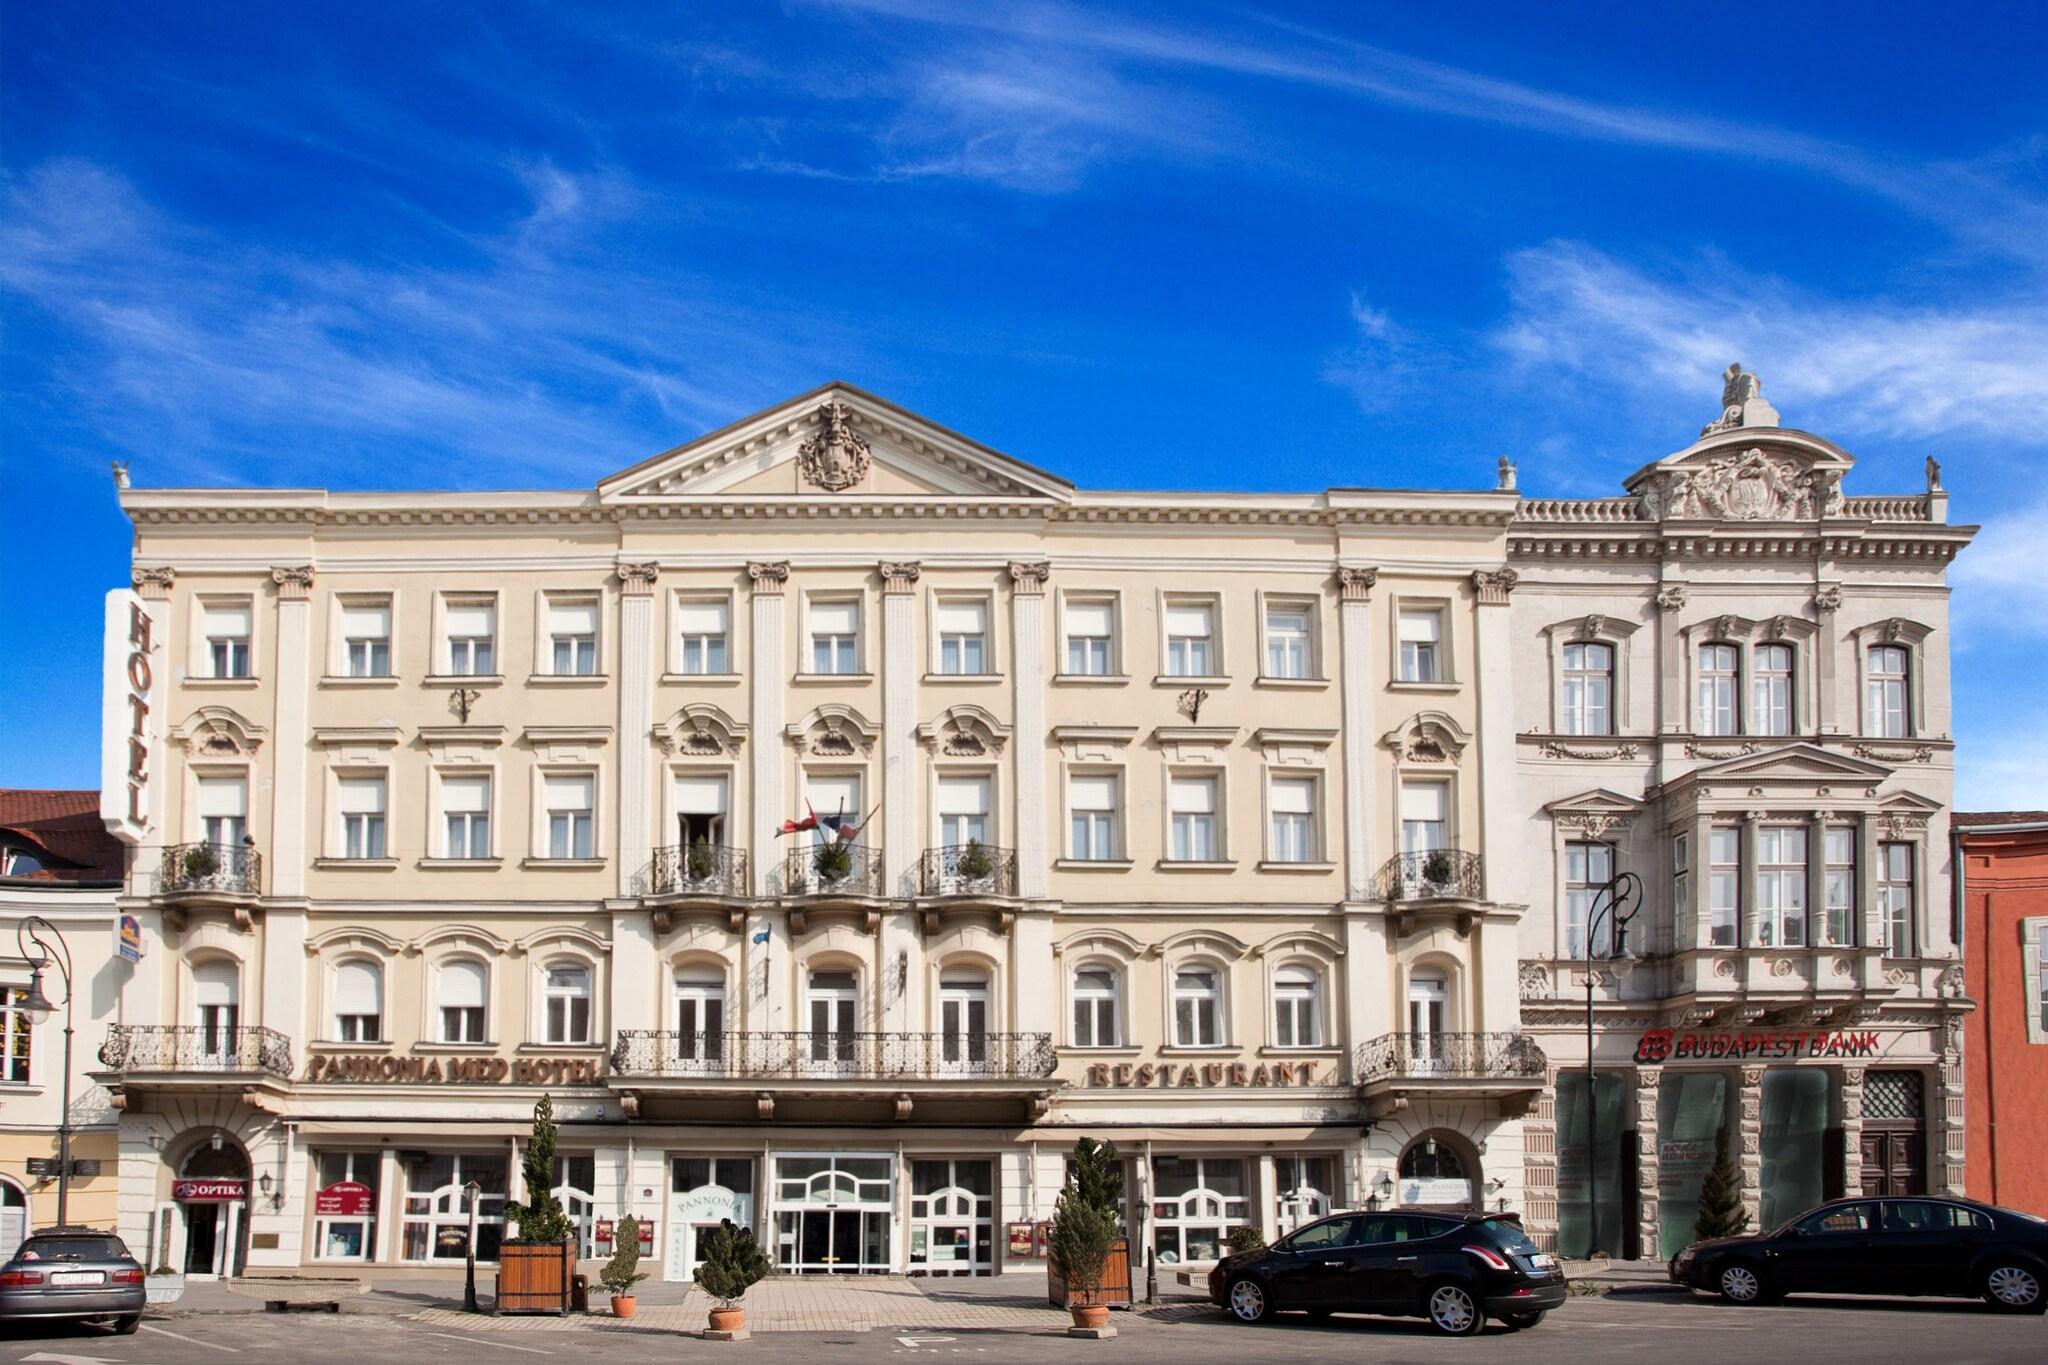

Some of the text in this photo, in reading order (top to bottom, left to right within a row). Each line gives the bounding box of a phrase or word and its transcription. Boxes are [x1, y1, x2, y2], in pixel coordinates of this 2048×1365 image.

[128, 601, 153, 826] HOTEL
[1681, 1031, 1881, 1053] BUDAPEST BANK
[310, 1054, 599, 1083] PANNONIA MED HOTEL
[1093, 1060, 1319, 1087] RESTAURANT
[197, 1185, 245, 1195] OPTIKA
[678, 1195, 741, 1213] PANNONIA
